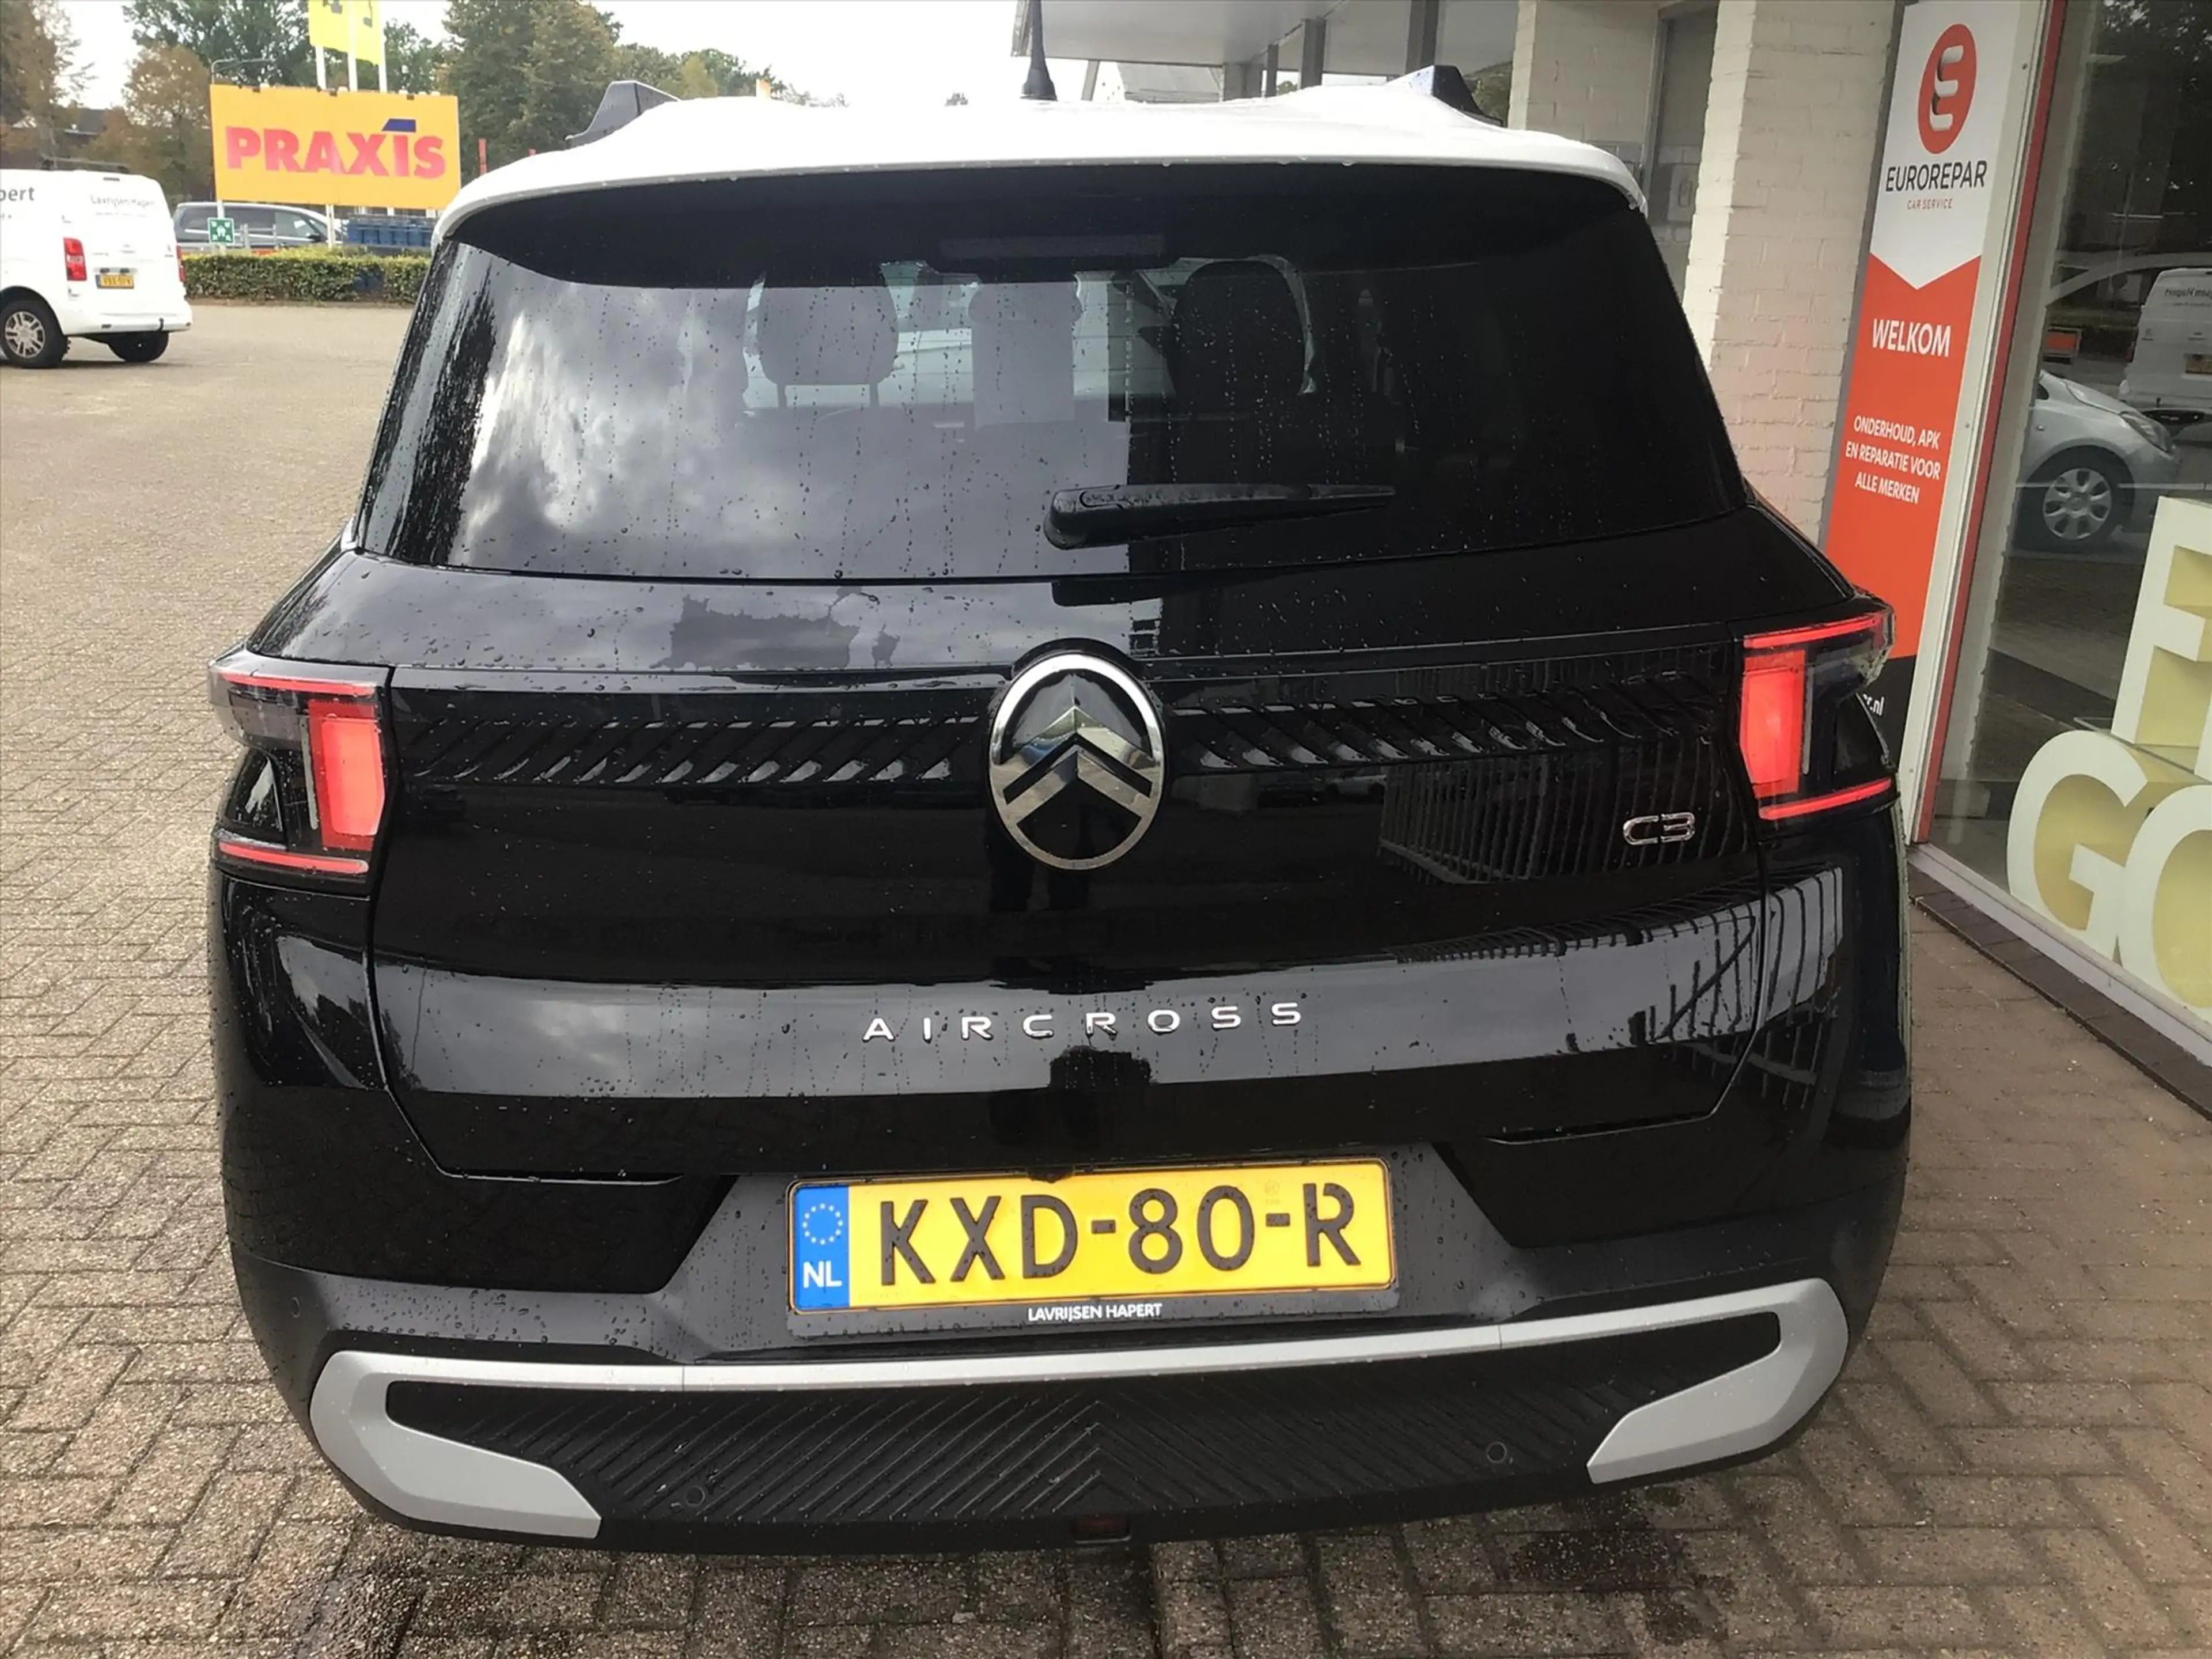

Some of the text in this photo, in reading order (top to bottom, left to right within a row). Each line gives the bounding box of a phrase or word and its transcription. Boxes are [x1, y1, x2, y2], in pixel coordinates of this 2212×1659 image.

[225, 126, 446, 179] PRAXIS
[1885, 160, 1987, 192] EUROREPAR
[1907, 198, 1952, 210] CAR SERVICE
[1873, 318, 1952, 357] WELKOM
[1854, 415, 1941, 450] ONDERHOUD, APK
[1846, 441, 1941, 480] EN REPARATIE VOOR
[1855, 472, 1921, 505] ALLE MERKEN
[1623, 812, 1695, 845] C3
[862, 1002, 1301, 1042] AIRCROSS
[880, 1183, 1361, 1286] KXD-80-R
[803, 1260, 842, 1288] NL
[1028, 1303, 1162, 1322] LAVRIJSEN HAPERT
